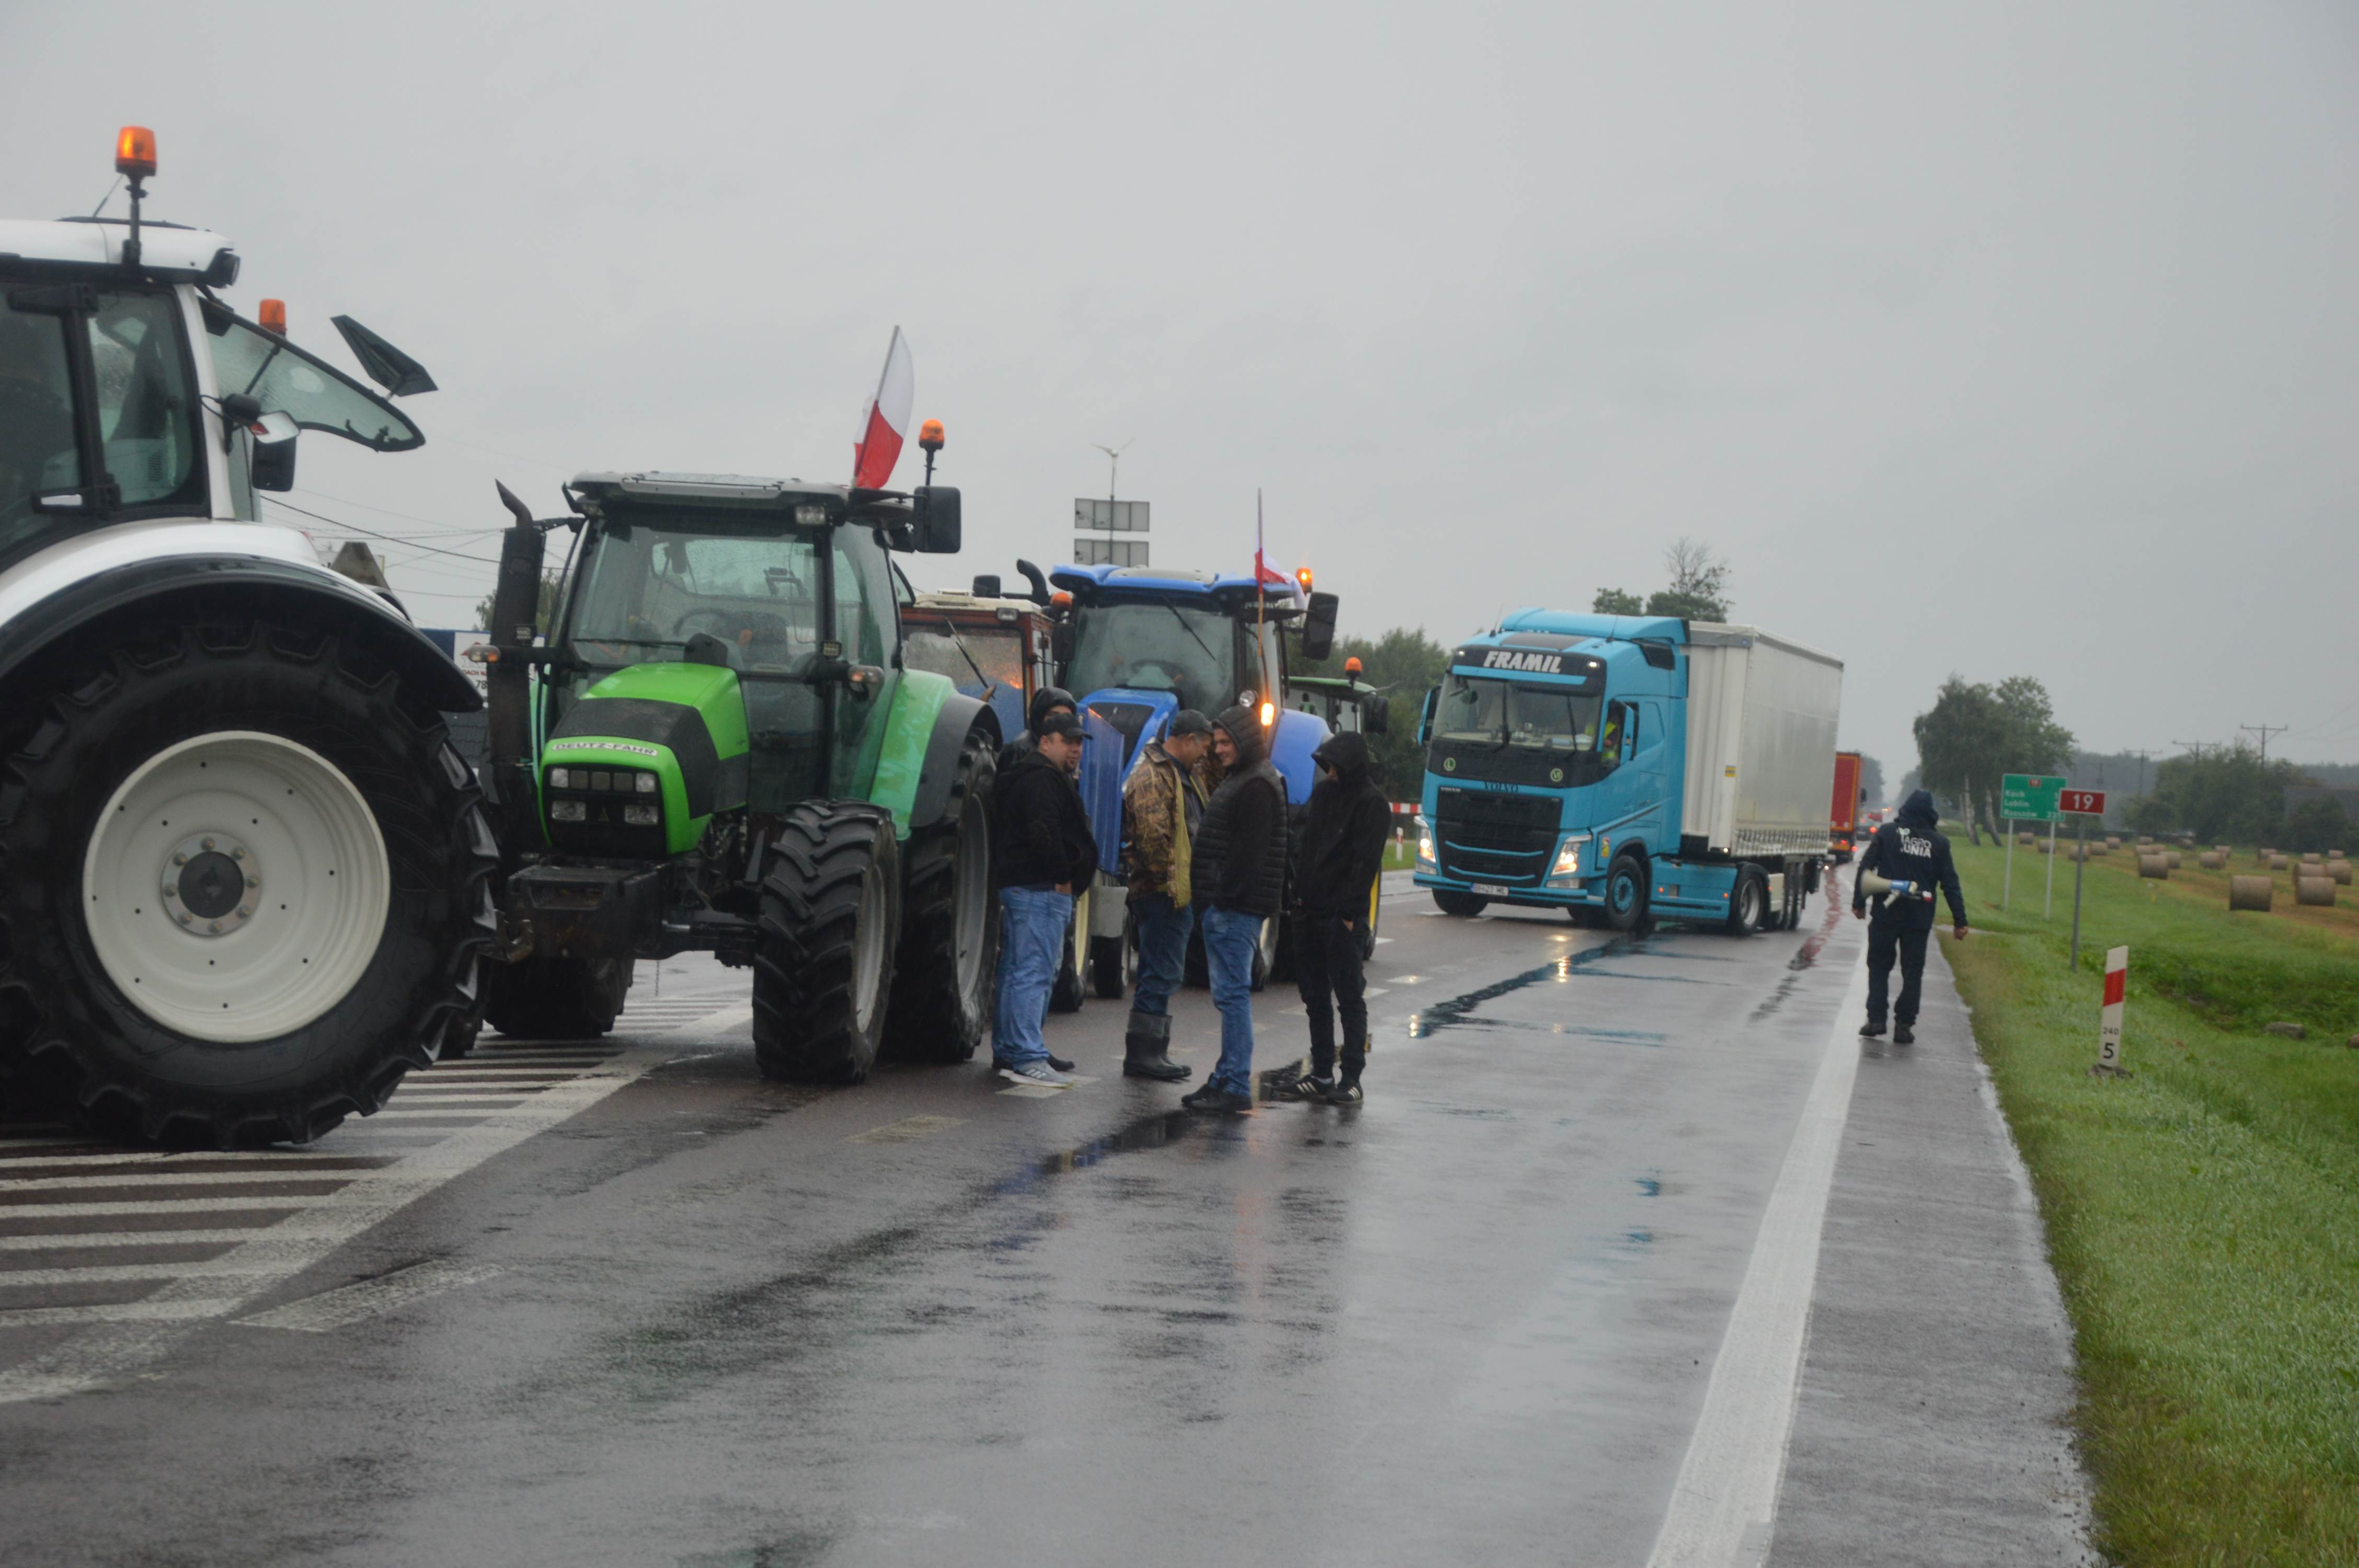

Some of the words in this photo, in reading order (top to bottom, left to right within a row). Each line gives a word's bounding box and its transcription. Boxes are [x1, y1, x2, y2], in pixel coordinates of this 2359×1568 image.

[1483, 651, 1562, 674] FRAMIL
[555, 742, 655, 755] DEUTZ-FAHR
[1483, 781, 1519, 793] VOLVO
[2073, 794, 2094, 810] 19
[1905, 836, 1932, 849] AGRO
[1904, 843, 1932, 858] UNIA
[2103, 1042, 2114, 1059] 5
